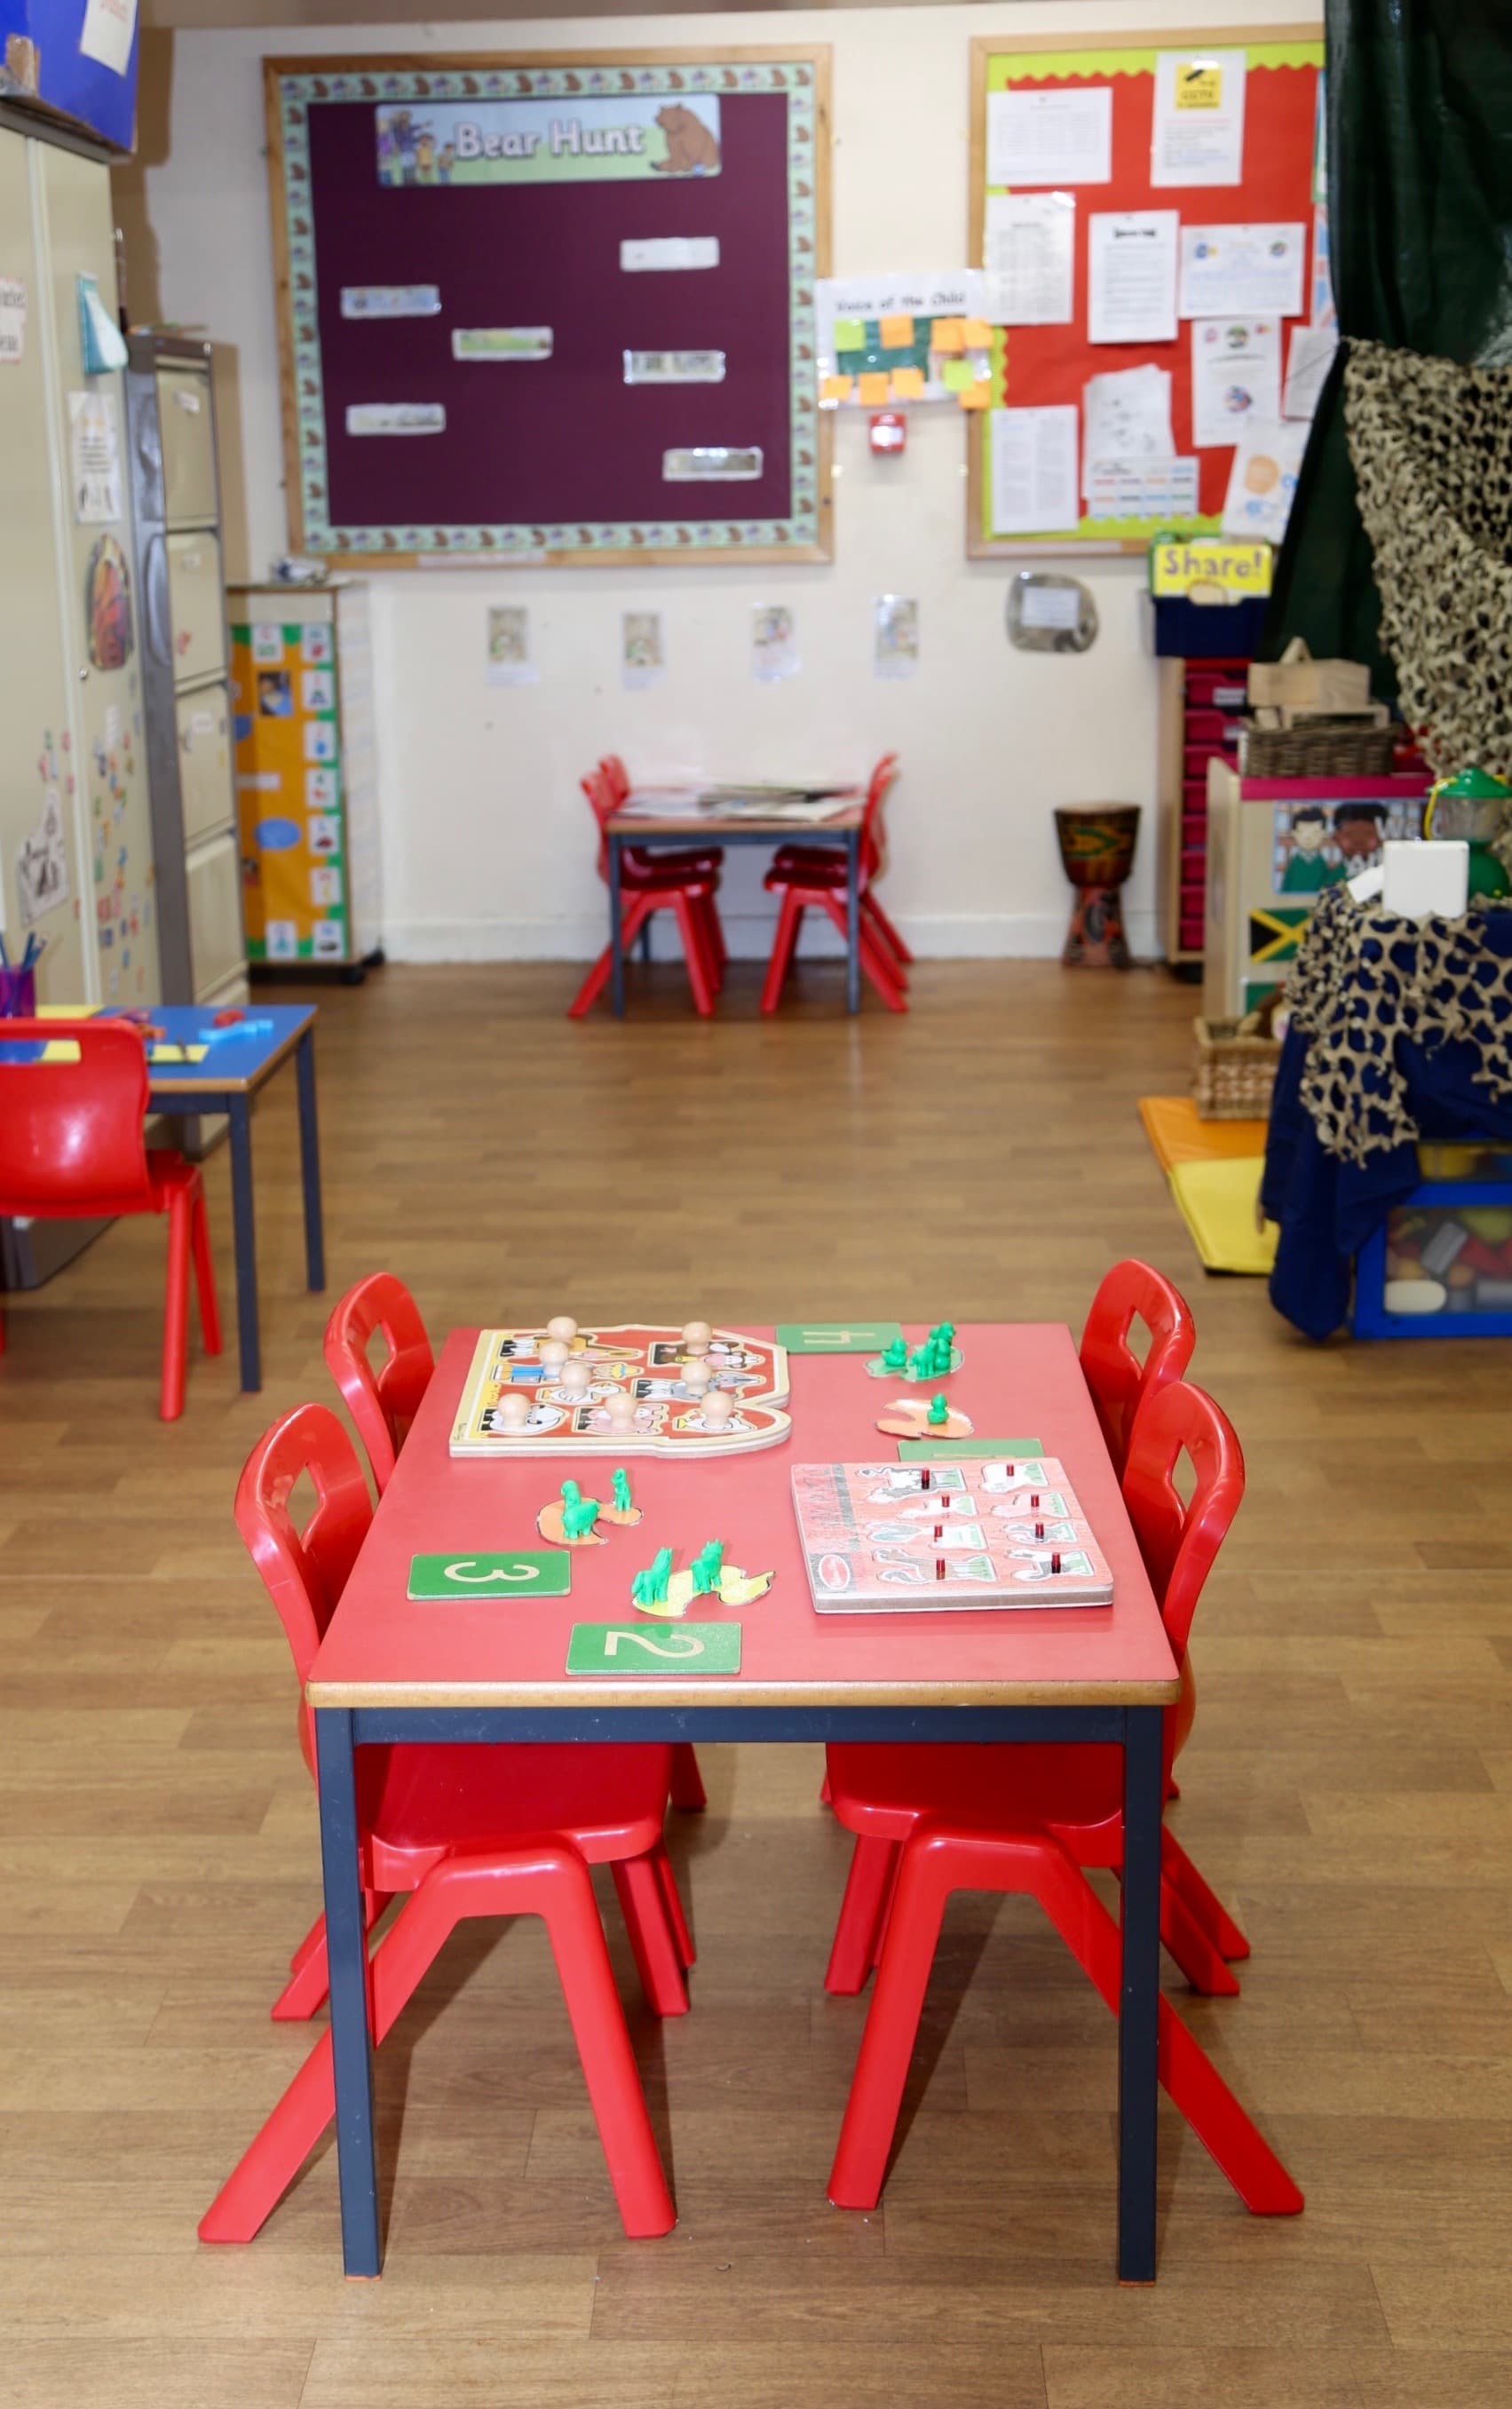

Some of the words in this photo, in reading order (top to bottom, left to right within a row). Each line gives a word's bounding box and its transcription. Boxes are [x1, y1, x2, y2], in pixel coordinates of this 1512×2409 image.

[454, 122, 540, 159] Bear
[550, 117, 646, 157] Hunt
[1163, 548, 1262, 577] Share!
[444, 1561, 540, 1583] 3
[604, 1630, 705, 1659] 2
